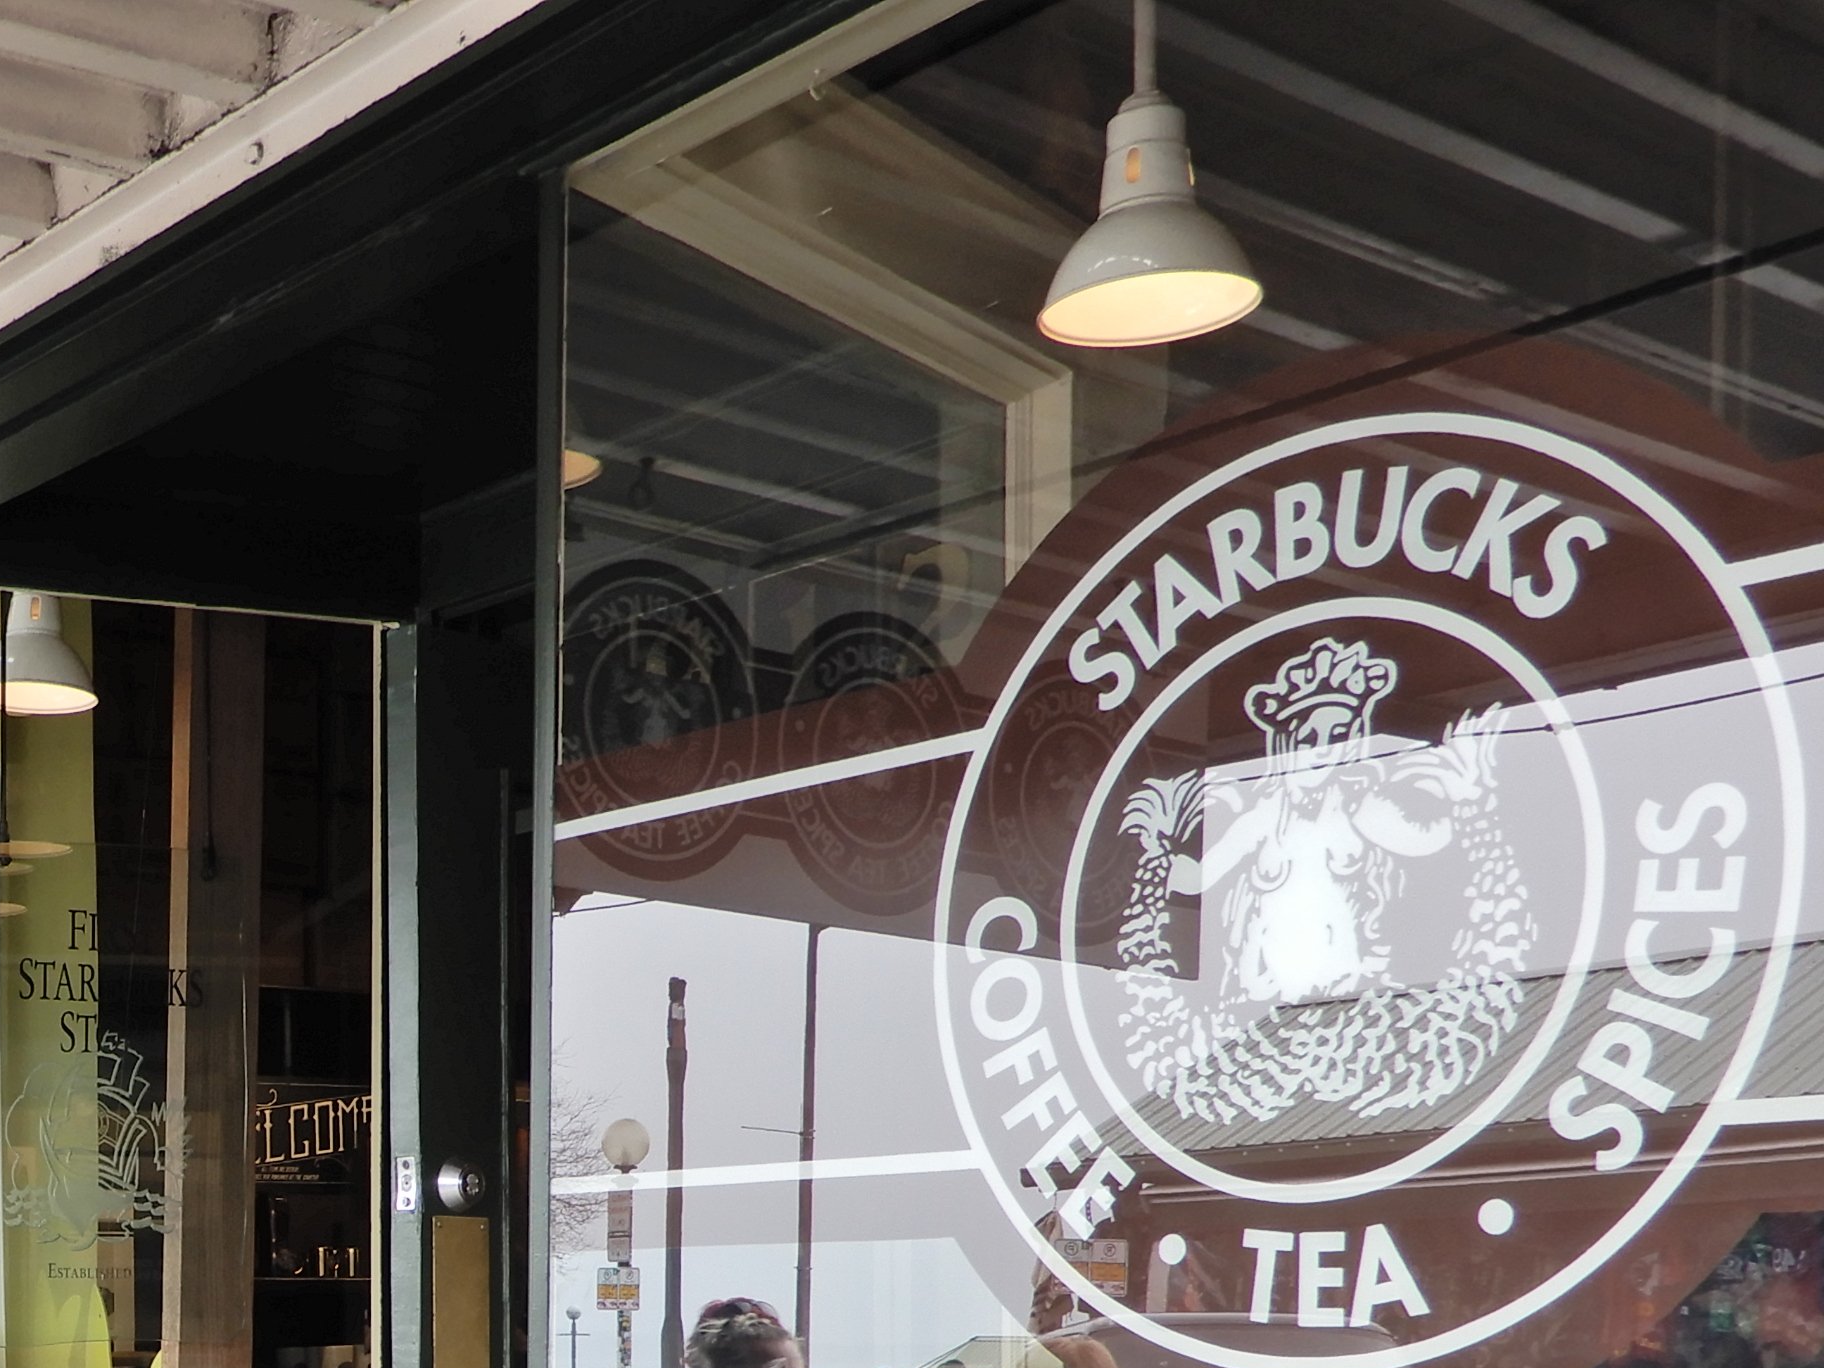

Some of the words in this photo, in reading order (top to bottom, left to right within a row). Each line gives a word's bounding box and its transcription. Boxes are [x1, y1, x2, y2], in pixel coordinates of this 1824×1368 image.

[1067, 464, 1608, 711] STARBUCKS
[965, 896, 1137, 1241] COFFEE
[1241, 1223, 1430, 1327] TEA
[1547, 781, 1747, 1171] SPICES
